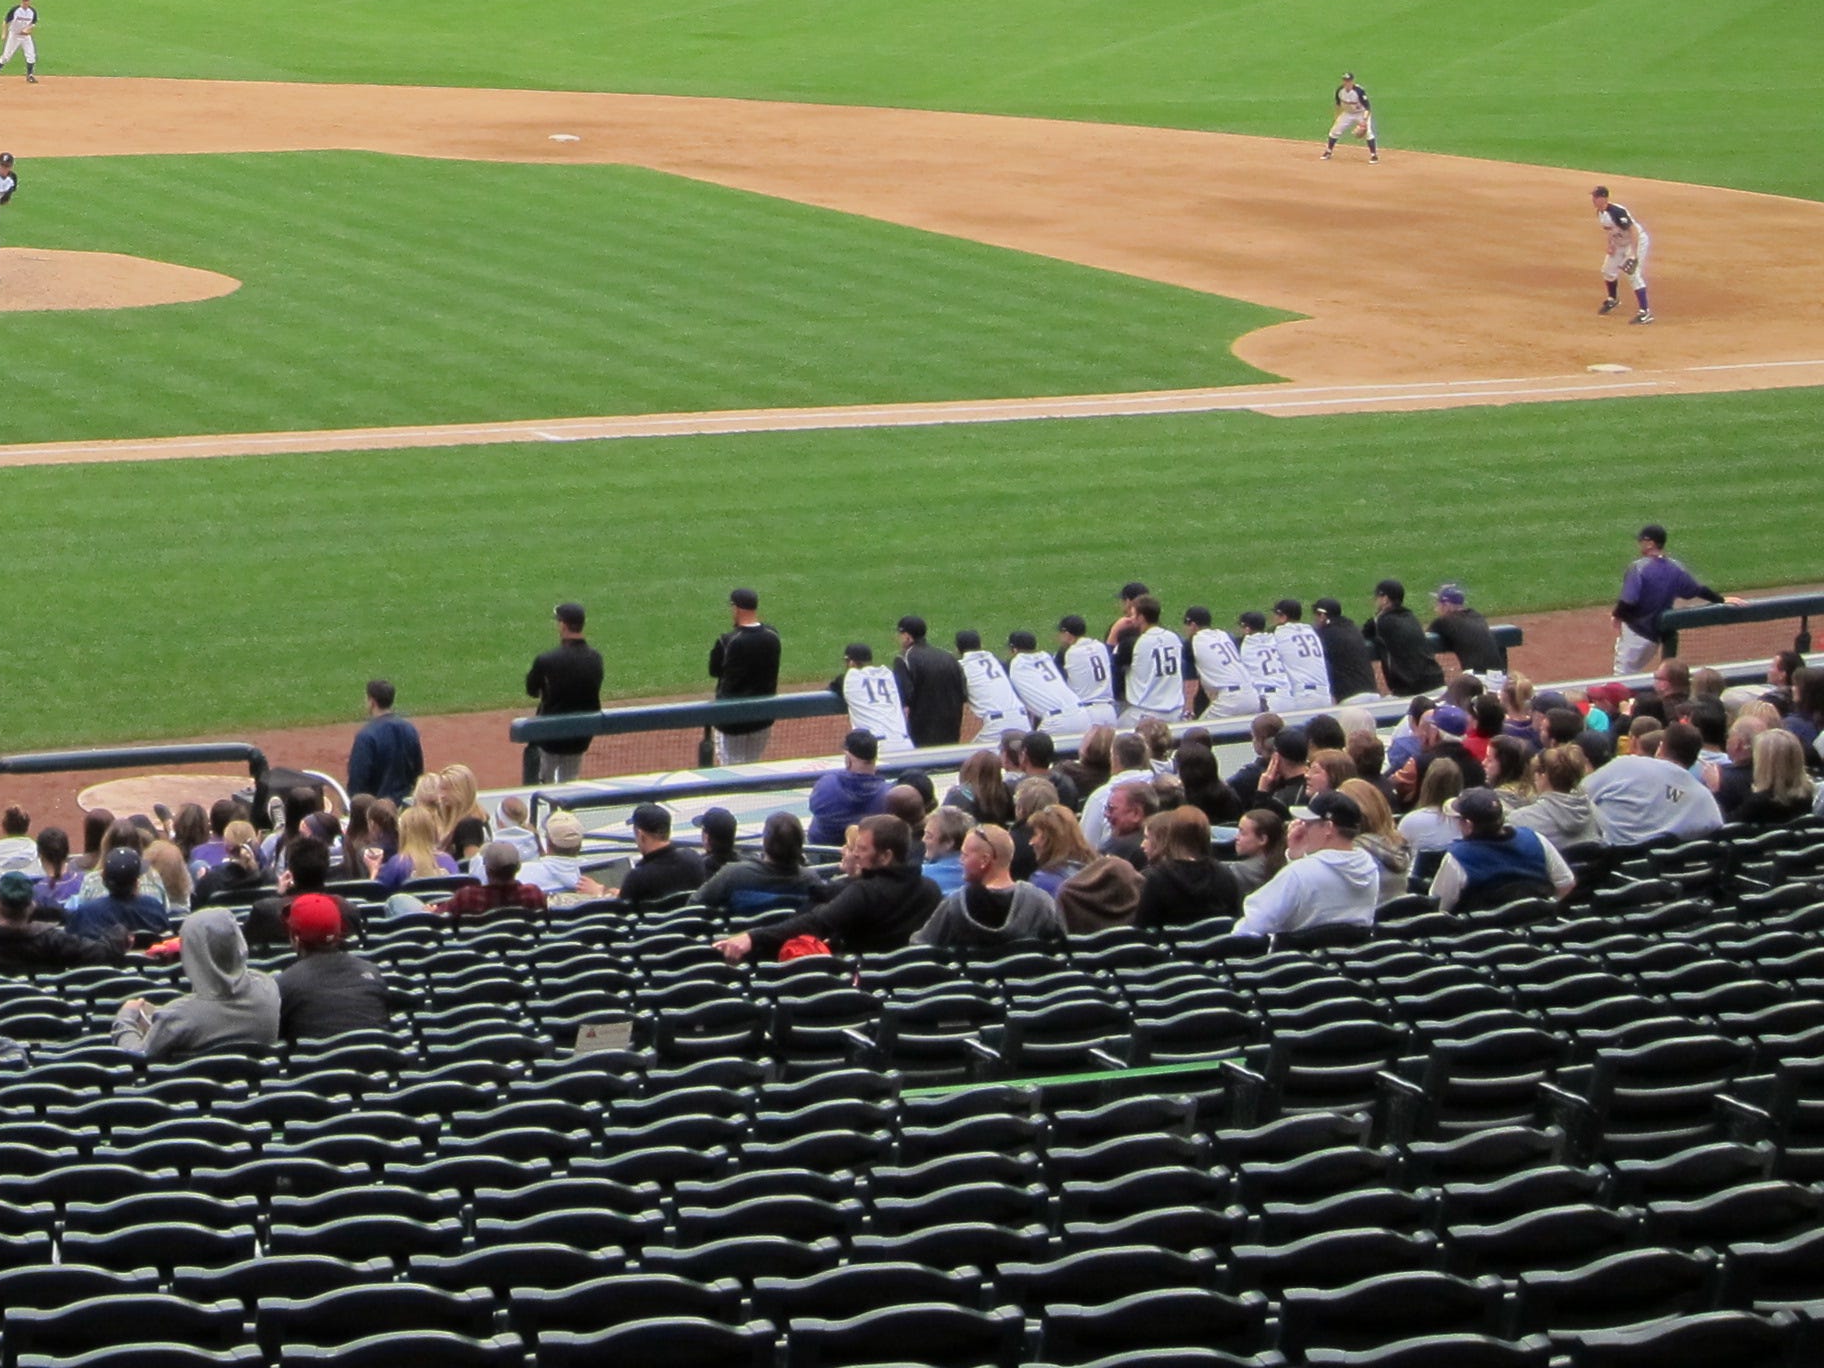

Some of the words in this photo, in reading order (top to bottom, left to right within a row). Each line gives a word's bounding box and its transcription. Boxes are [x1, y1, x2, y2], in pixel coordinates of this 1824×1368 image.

[1210, 642, 1242, 667] 30
[1293, 633, 1323, 659] 33
[979, 658, 1001, 680] 2
[1035, 660, 1057, 682] 3
[1090, 654, 1107, 683] 8
[1152, 645, 1177, 678] 15
[862, 677, 894, 704] 14
[1665, 783, 1685, 804] W
